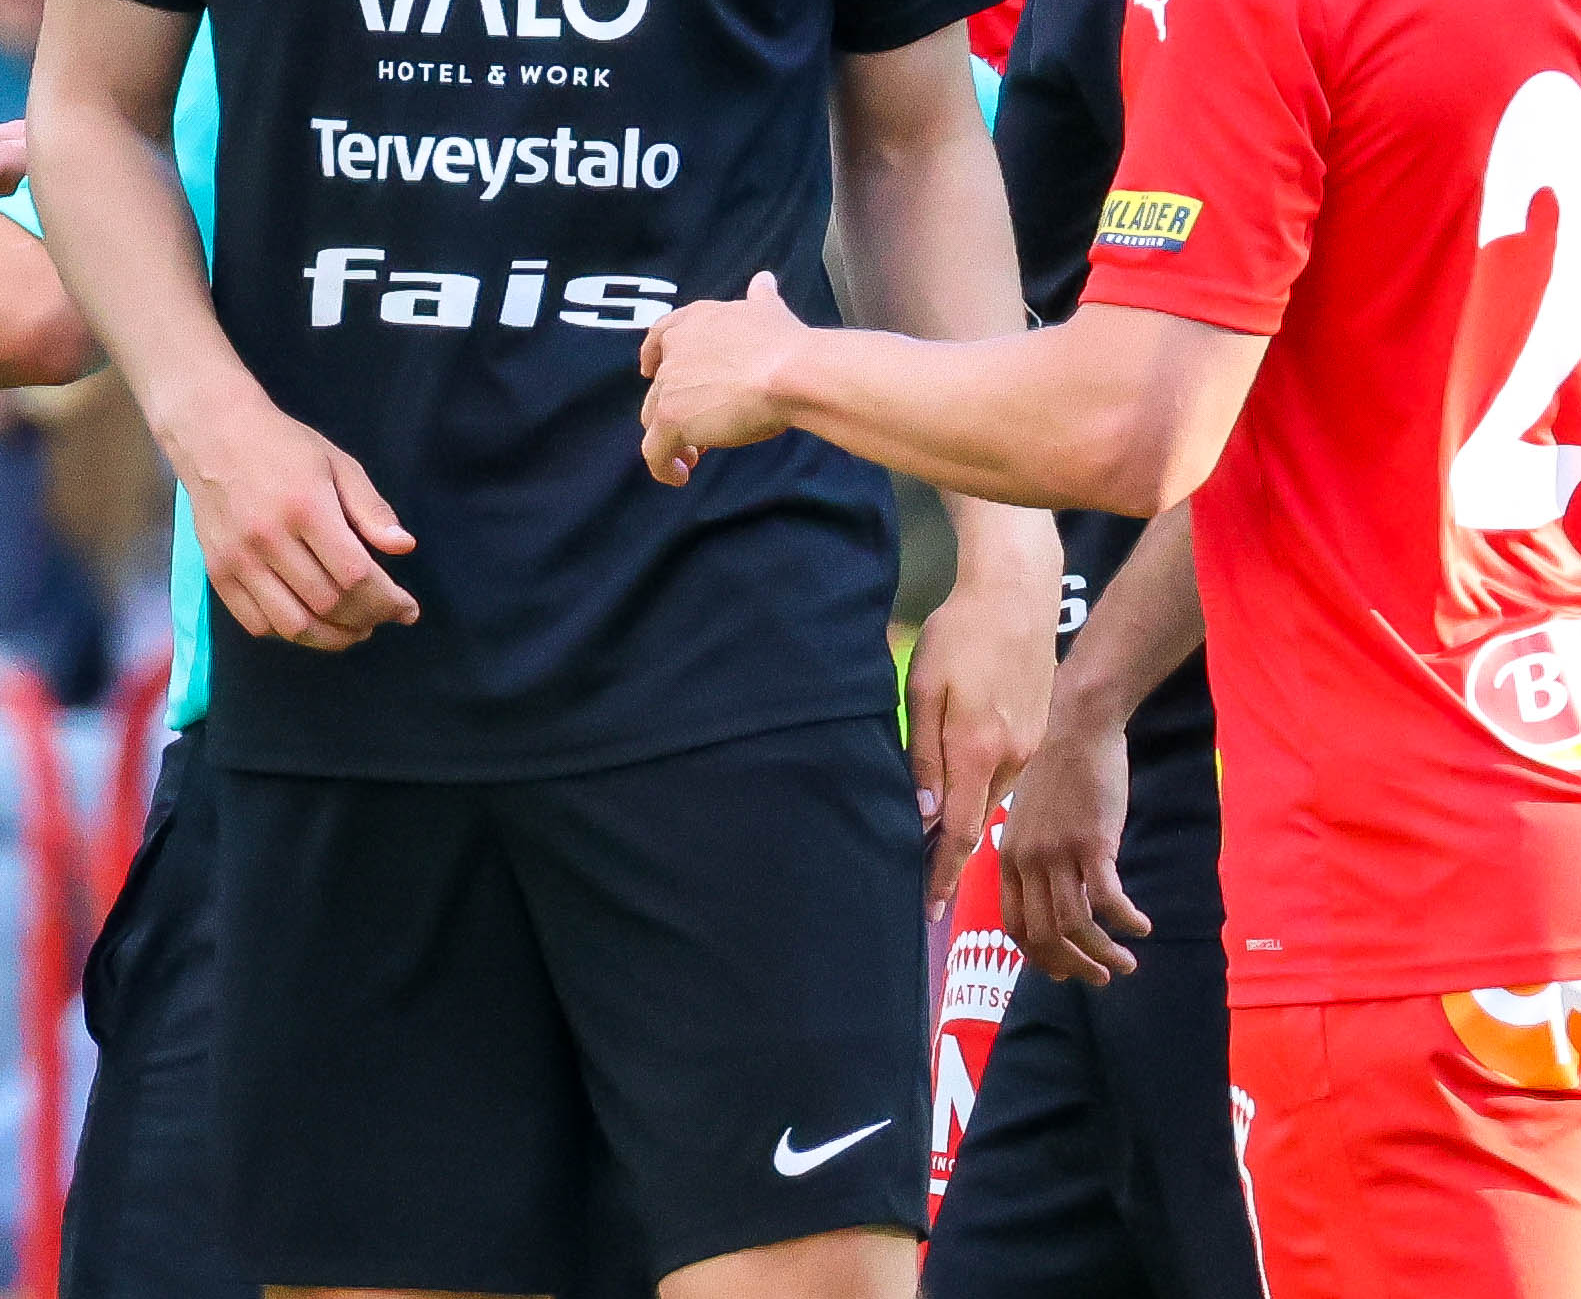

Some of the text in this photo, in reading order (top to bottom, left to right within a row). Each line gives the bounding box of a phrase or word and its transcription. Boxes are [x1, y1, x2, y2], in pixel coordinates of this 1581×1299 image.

[377, 60, 612, 88] HOTEL & WORK
[310, 117, 680, 201] Terveystalo
[303, 246, 678, 329] fais
